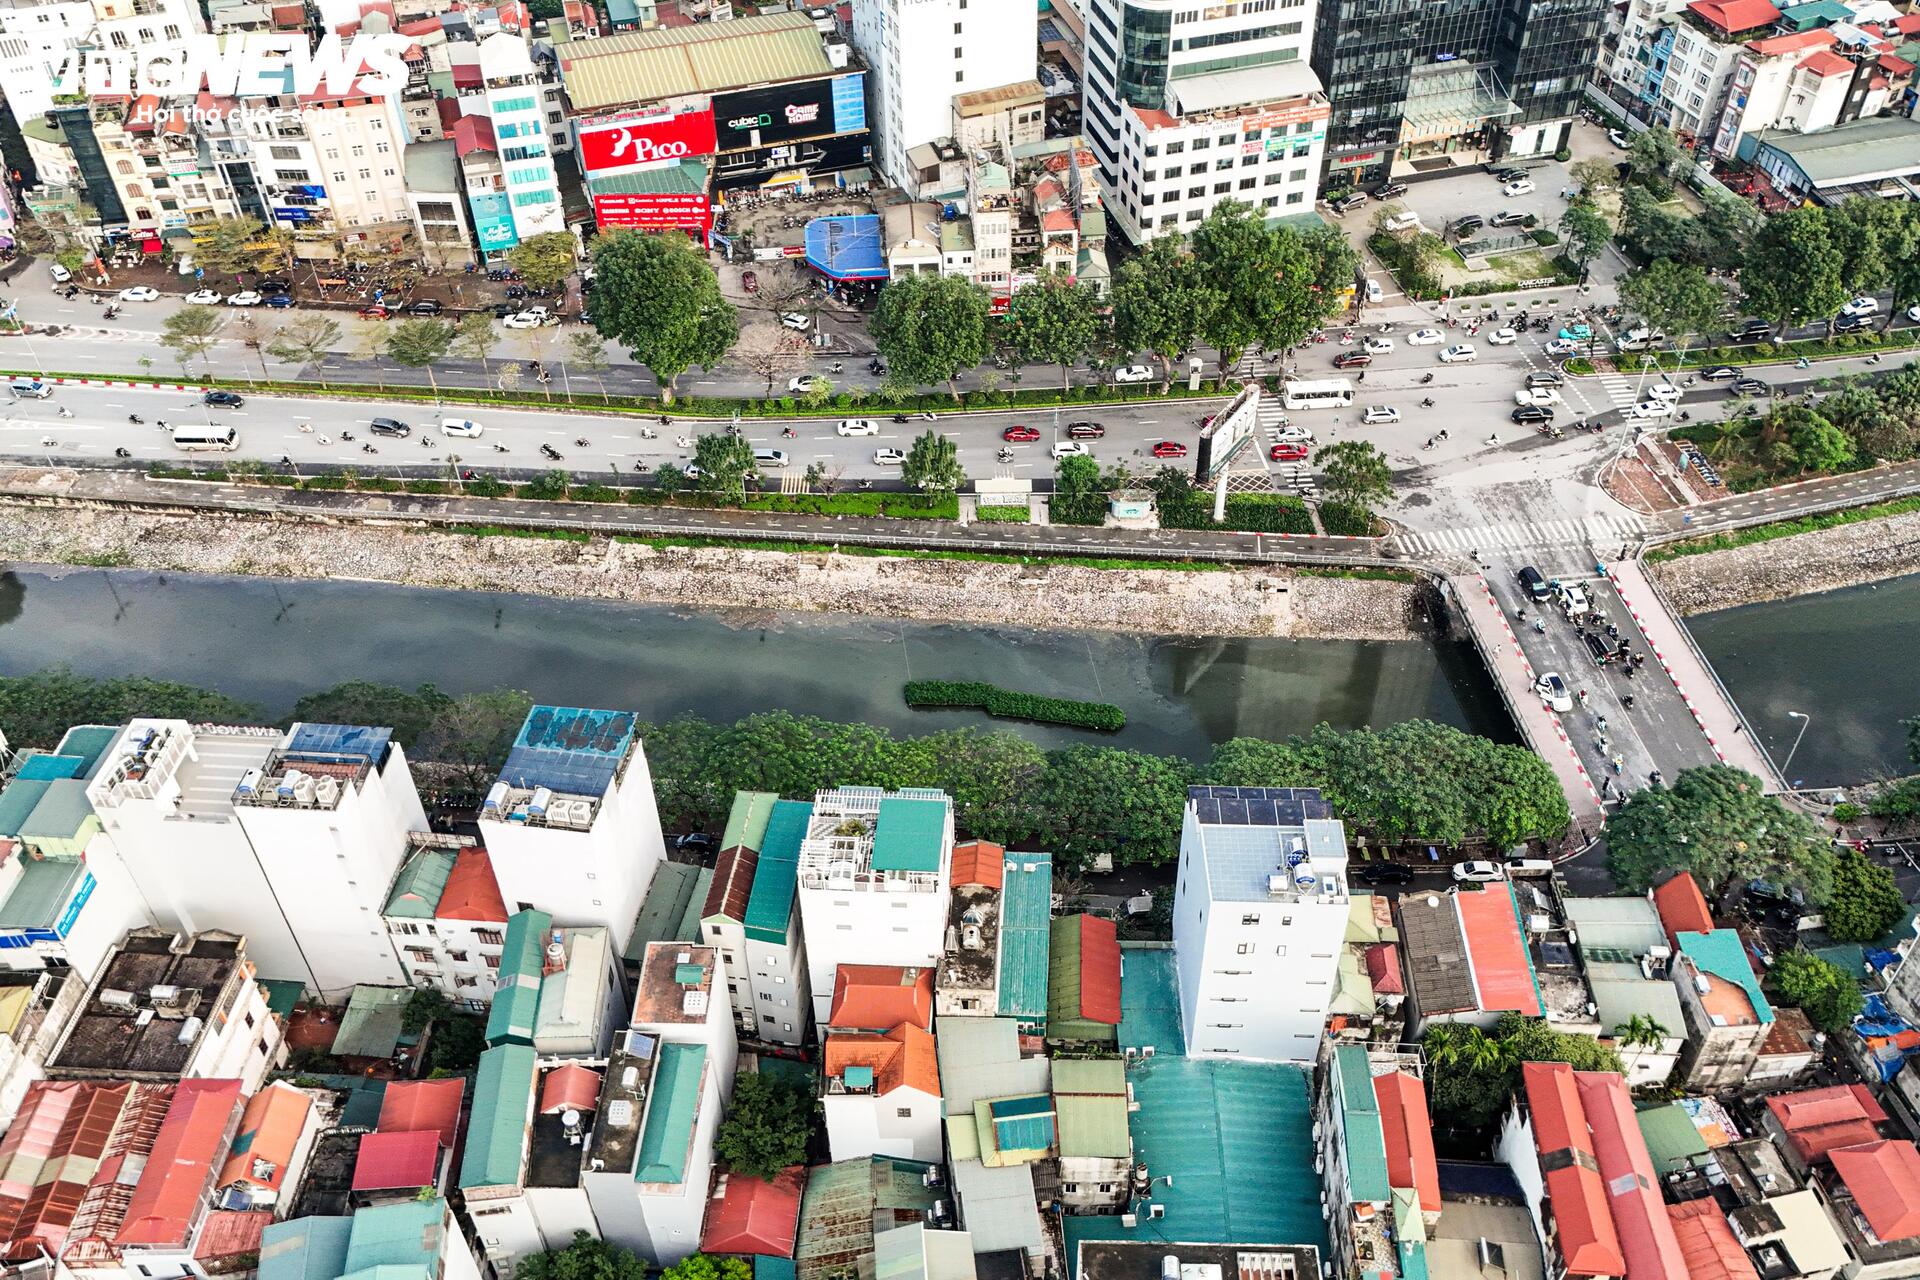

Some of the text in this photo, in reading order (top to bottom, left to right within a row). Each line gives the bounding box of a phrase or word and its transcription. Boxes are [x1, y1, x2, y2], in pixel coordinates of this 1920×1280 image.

[785, 103, 819, 118] GAME
[728, 115, 759, 128] cubic
[788, 112, 818, 124] HOME
